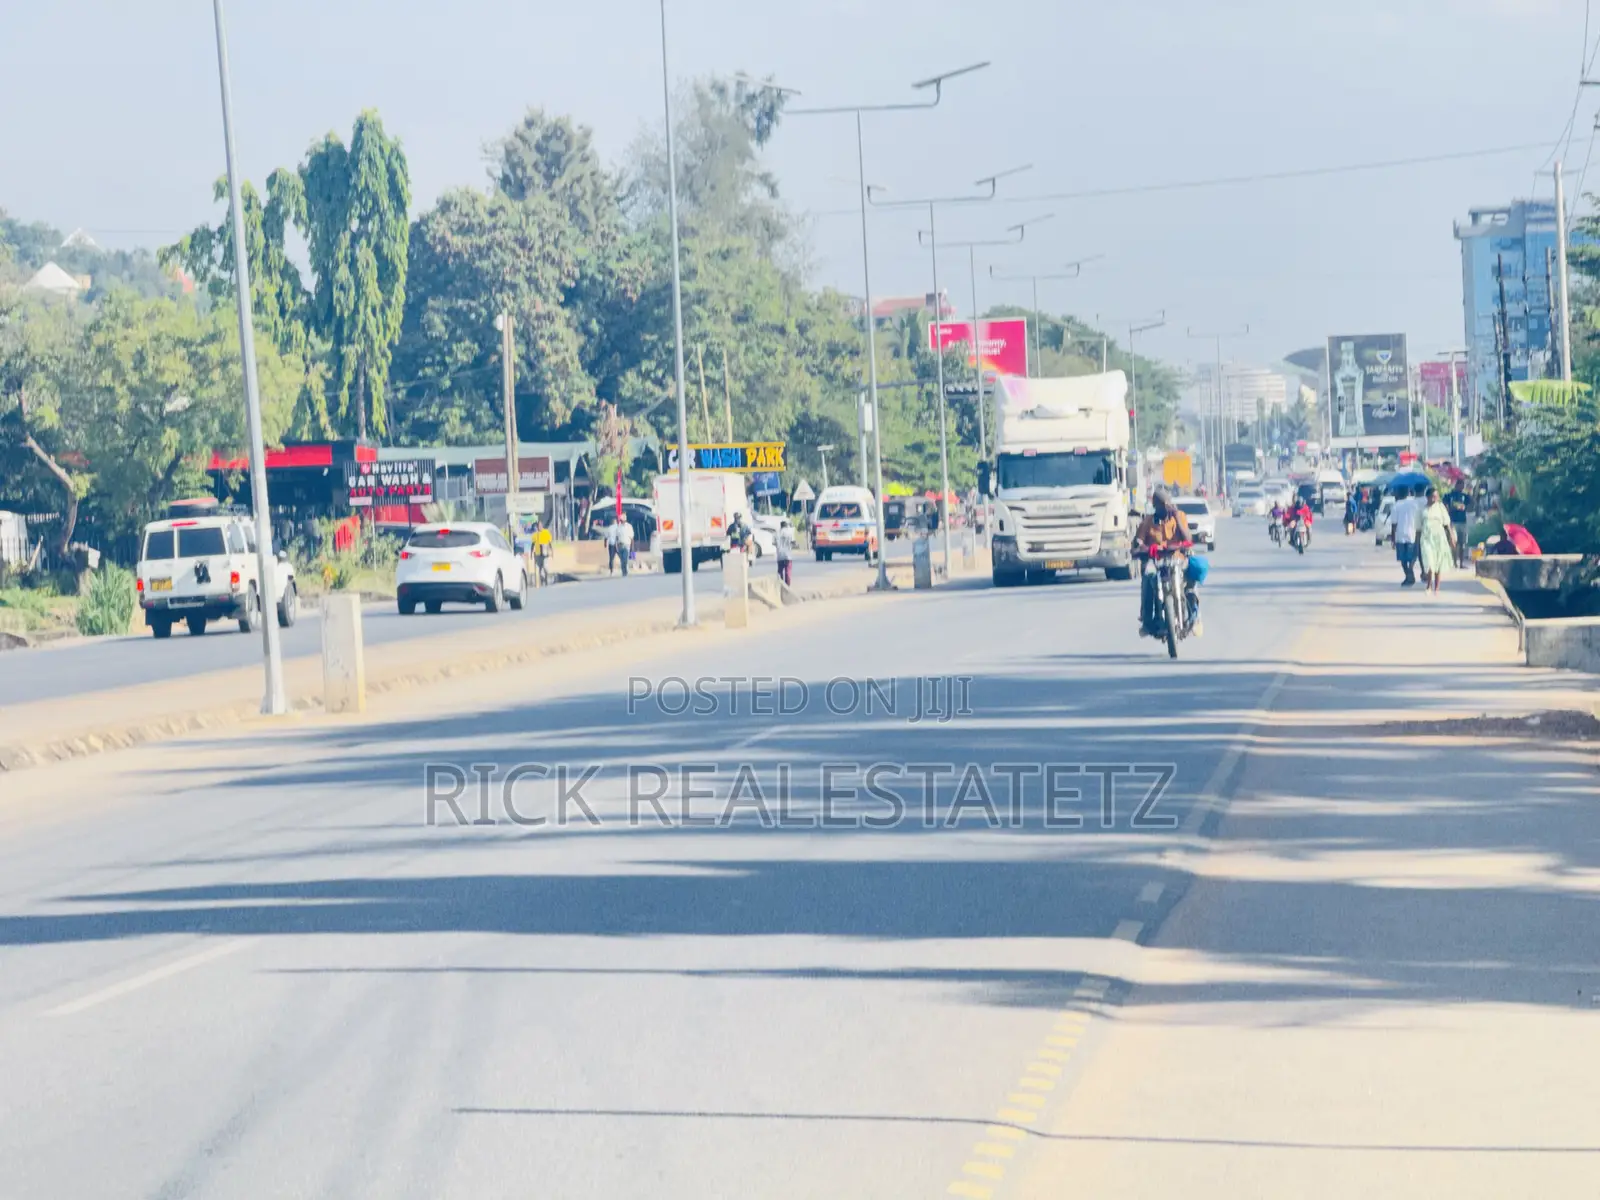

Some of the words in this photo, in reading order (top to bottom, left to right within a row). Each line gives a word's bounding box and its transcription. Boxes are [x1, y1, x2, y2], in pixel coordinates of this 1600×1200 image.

[668, 448, 696, 469] CR
[700, 447, 741, 469] WASH
[745, 446, 784, 468] PARK
[349, 486, 385, 497] AUTO
